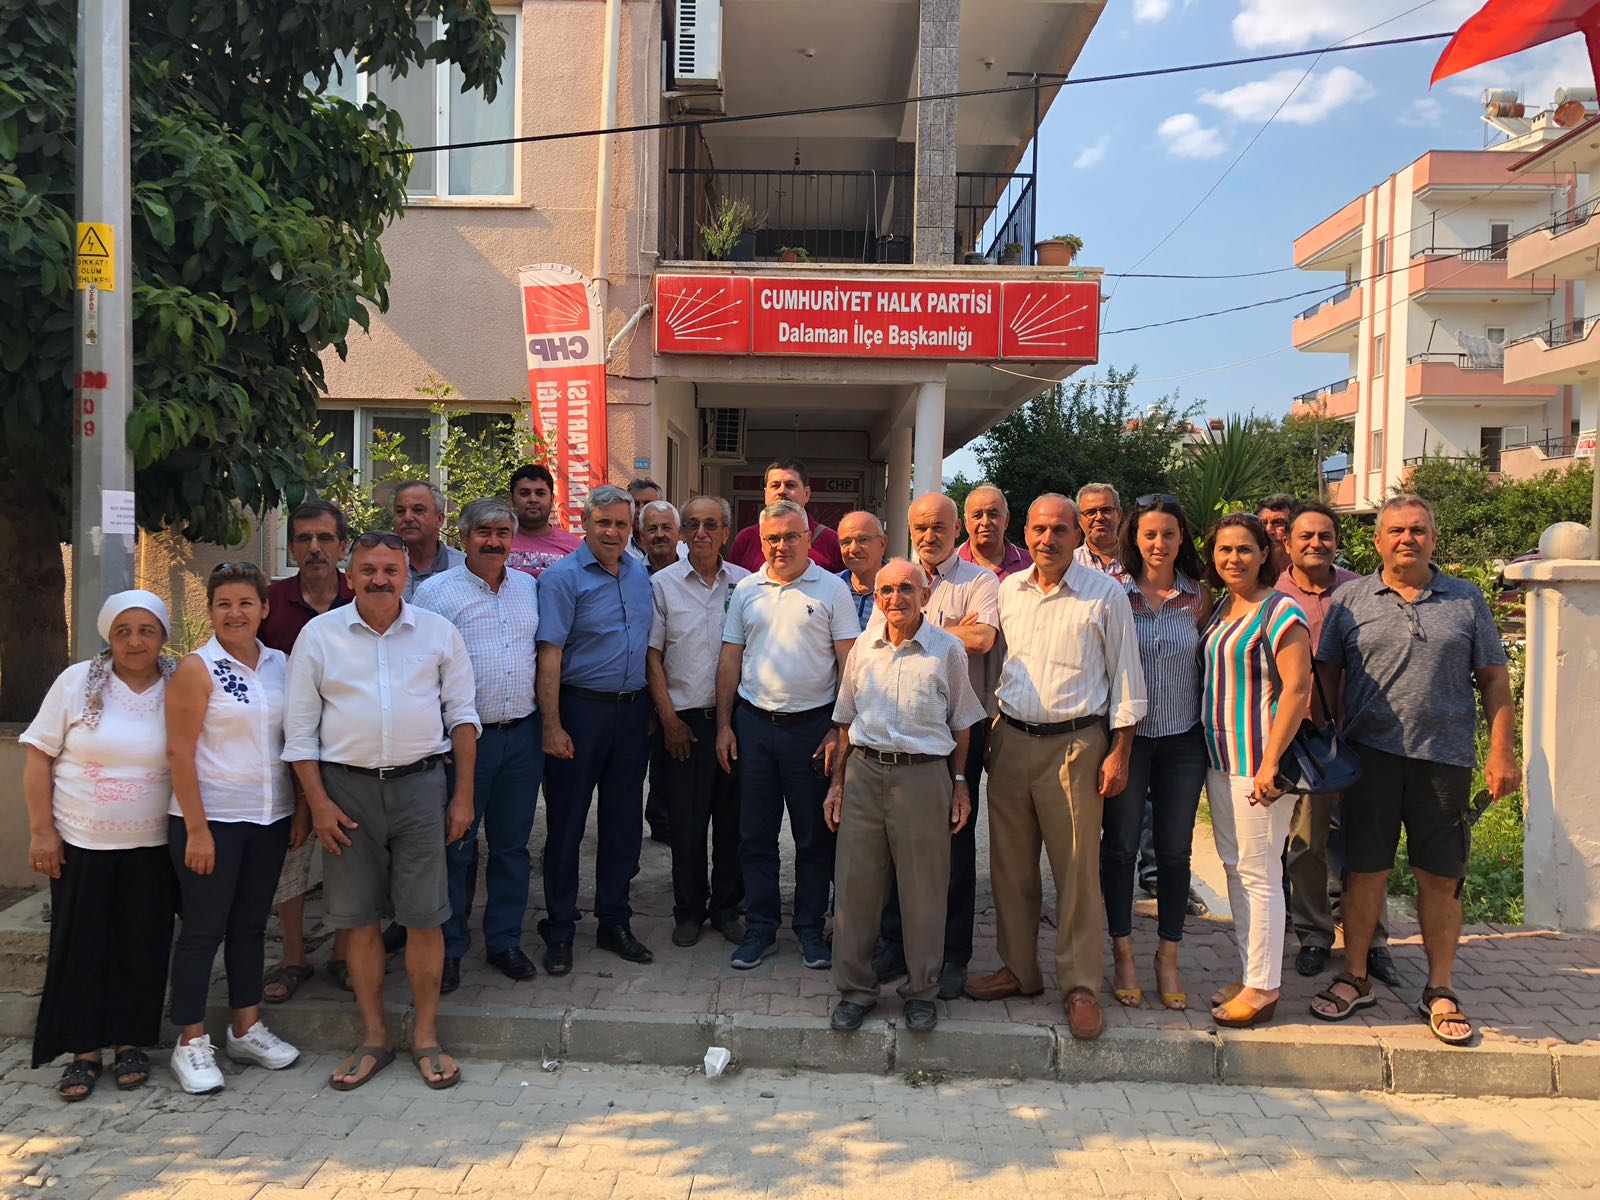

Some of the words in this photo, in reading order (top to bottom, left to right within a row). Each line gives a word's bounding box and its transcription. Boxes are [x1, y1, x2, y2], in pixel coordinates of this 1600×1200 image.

[760, 285, 872, 312] CUMHURİYET
[877, 291, 922, 313] HALK
[927, 289, 992, 314] PARTİSİ
[778, 321, 848, 344] Dalaman
[853, 320, 884, 349] İlçe
[888, 324, 972, 351] Başkanlığı
[828, 479, 852, 489] CHP
